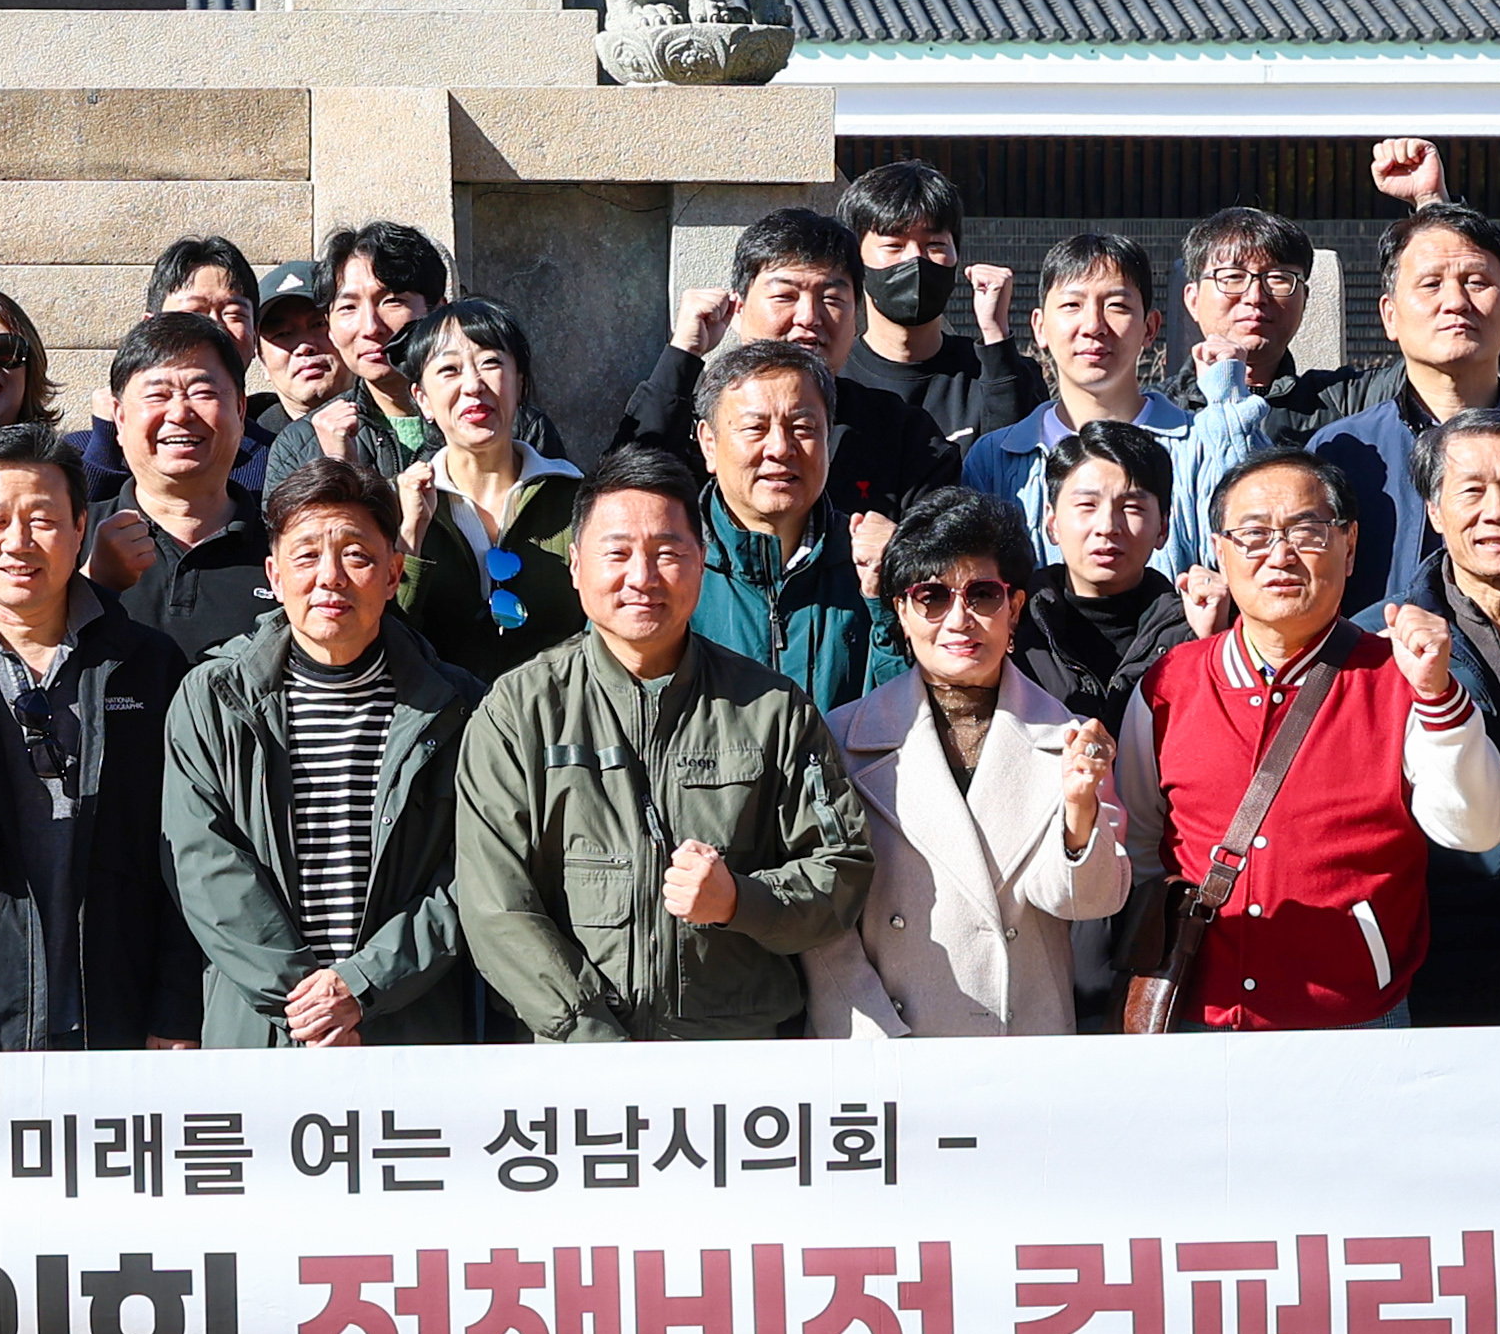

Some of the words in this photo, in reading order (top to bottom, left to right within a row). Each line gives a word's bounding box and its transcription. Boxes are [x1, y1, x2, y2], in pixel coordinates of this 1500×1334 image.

[104, 696, 136, 704] NATIONAL
[676, 756, 717, 771] Jeep
[10, 1112, 254, 1198] 미래를
[290, 1109, 451, 1194] 여는
[483, 1101, 898, 1192] 성남시의회
